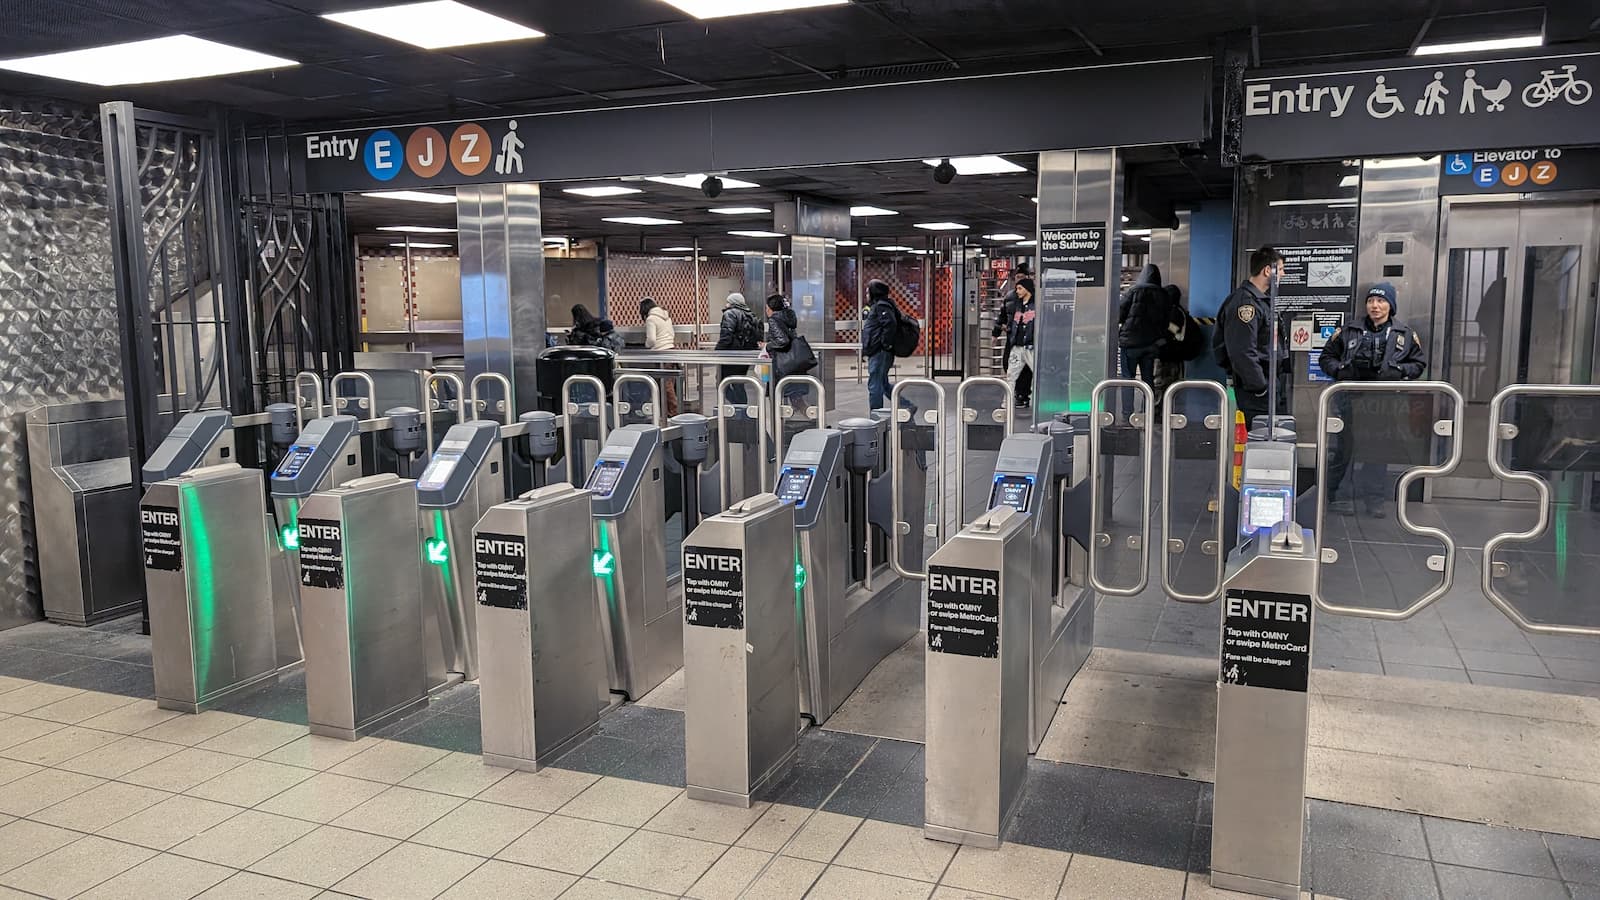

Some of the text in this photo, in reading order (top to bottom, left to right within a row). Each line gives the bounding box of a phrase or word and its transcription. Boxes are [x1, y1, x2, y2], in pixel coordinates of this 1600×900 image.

[1246, 82, 1354, 118] Entry
[306, 133, 480, 169] Entry E J Z
[1474, 148, 1561, 162] Elevator to
[1480, 166, 1550, 182] E J Z
[1042, 230, 1100, 240] Welcome to
[1042, 240, 1099, 250] the Subway
[142, 510, 178, 526] ENTER
[299, 524, 340, 540] ENTER
[476, 538, 524, 557] ENTER
[685, 553, 740, 572] ENTER
[929, 573, 997, 596] ENTER
[711, 588, 742, 596] MetroCard
[944, 602, 958, 610] with
[959, 603, 982, 612] OMNY
[1226, 598, 1308, 622] ENTER
[939, 611, 958, 619] swipe
[960, 612, 997, 622] MetroCard
[961, 627, 984, 635] charged
[1226, 627, 1289, 641] Tap with OMNY
[1236, 640, 1260, 648] swipe
[1262, 641, 1307, 652] MetroCard
[1263, 657, 1291, 666] charged
